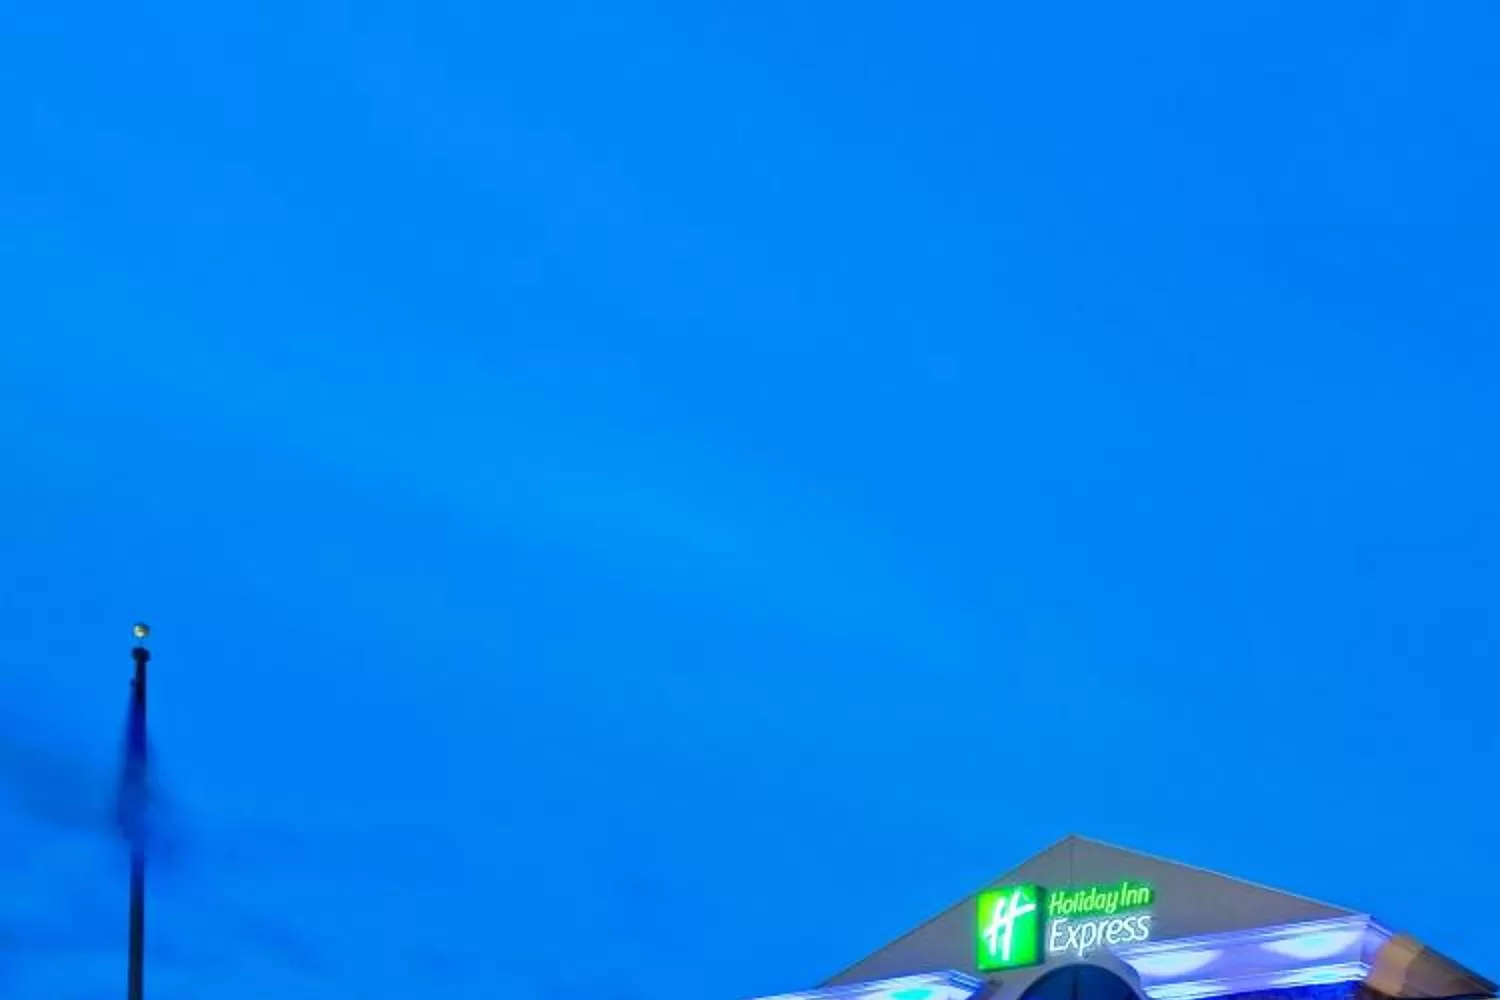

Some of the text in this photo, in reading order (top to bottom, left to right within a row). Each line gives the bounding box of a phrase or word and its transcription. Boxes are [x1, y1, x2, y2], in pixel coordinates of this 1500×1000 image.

[1048, 881, 1150, 916] Holiday Inn
[1049, 915, 1151, 956] Express
